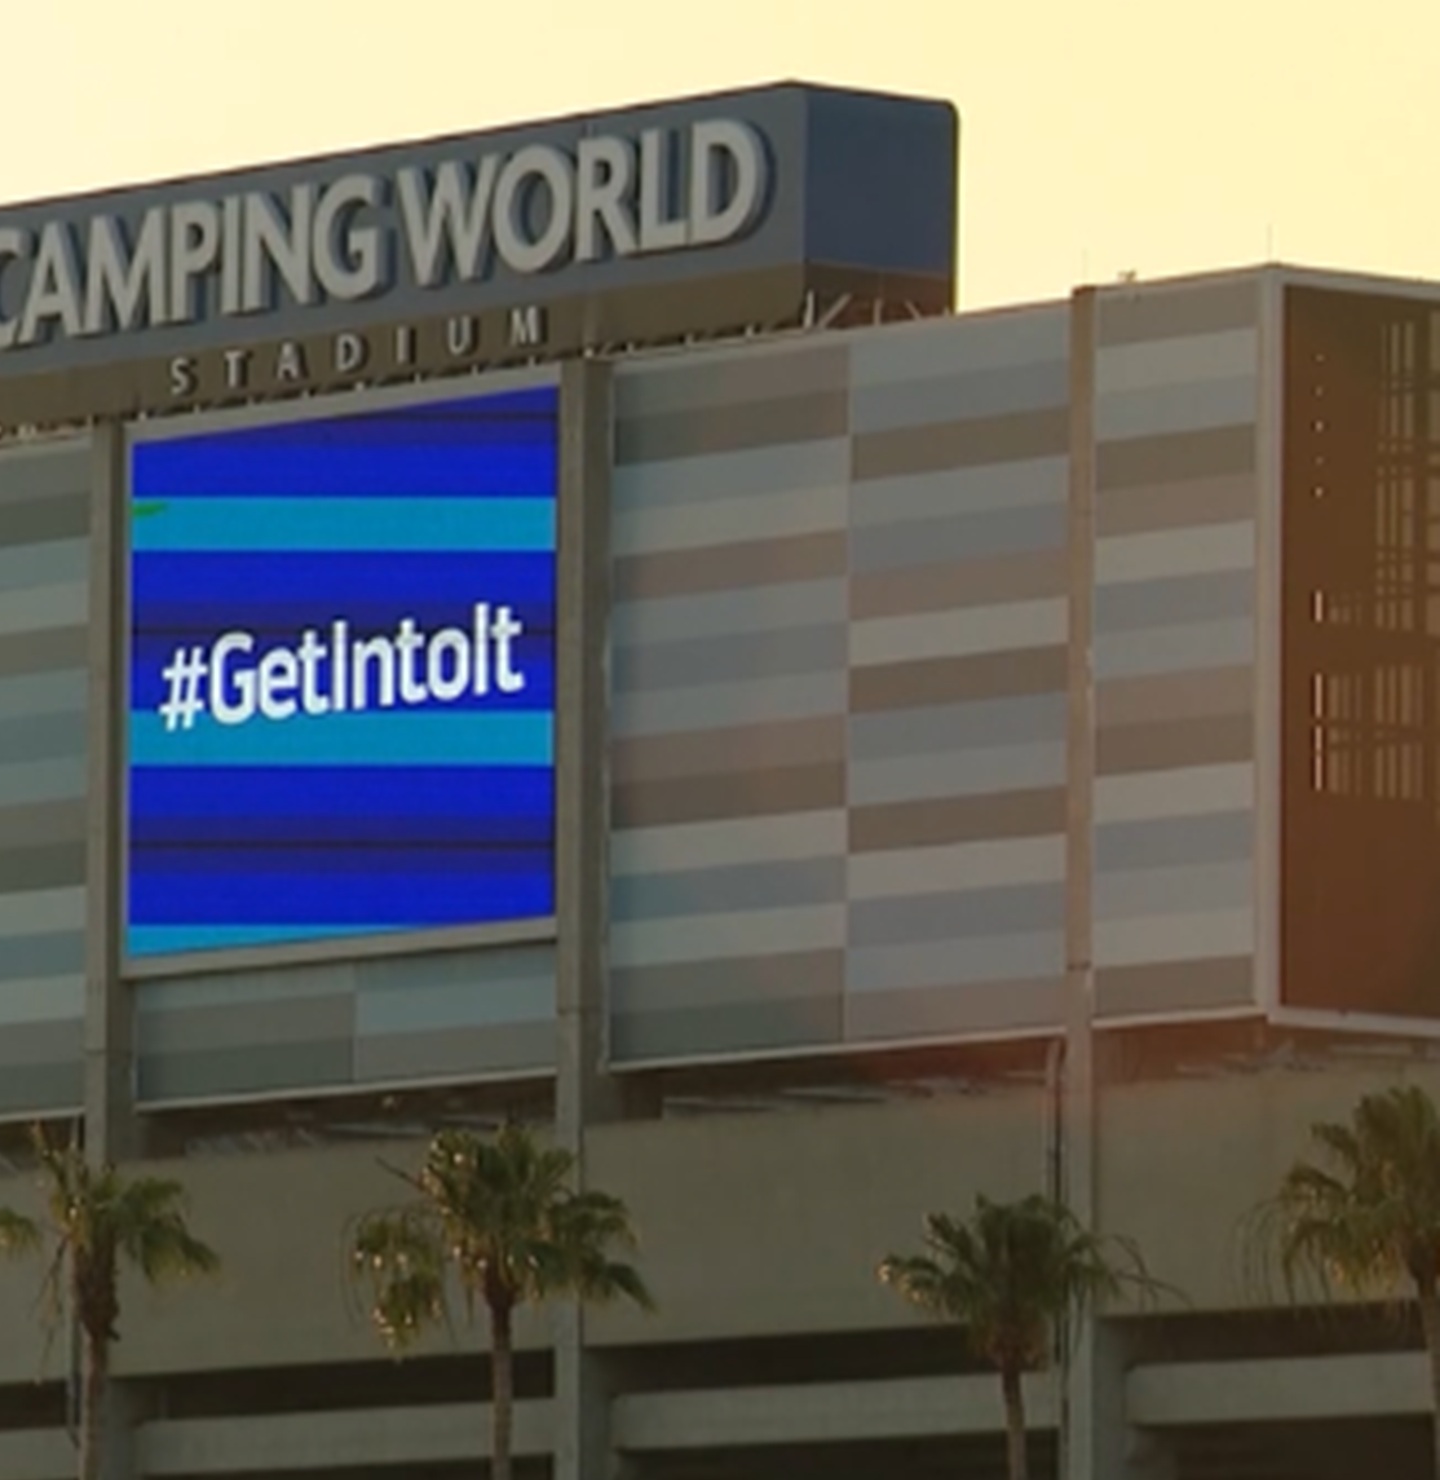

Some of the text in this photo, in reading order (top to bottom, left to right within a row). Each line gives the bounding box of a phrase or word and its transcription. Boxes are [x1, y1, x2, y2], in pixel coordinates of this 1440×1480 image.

[396, 117, 767, 286] WORLD
[169, 306, 550, 395] STADIUM
[159, 602, 526, 732] #GetIntoIt
